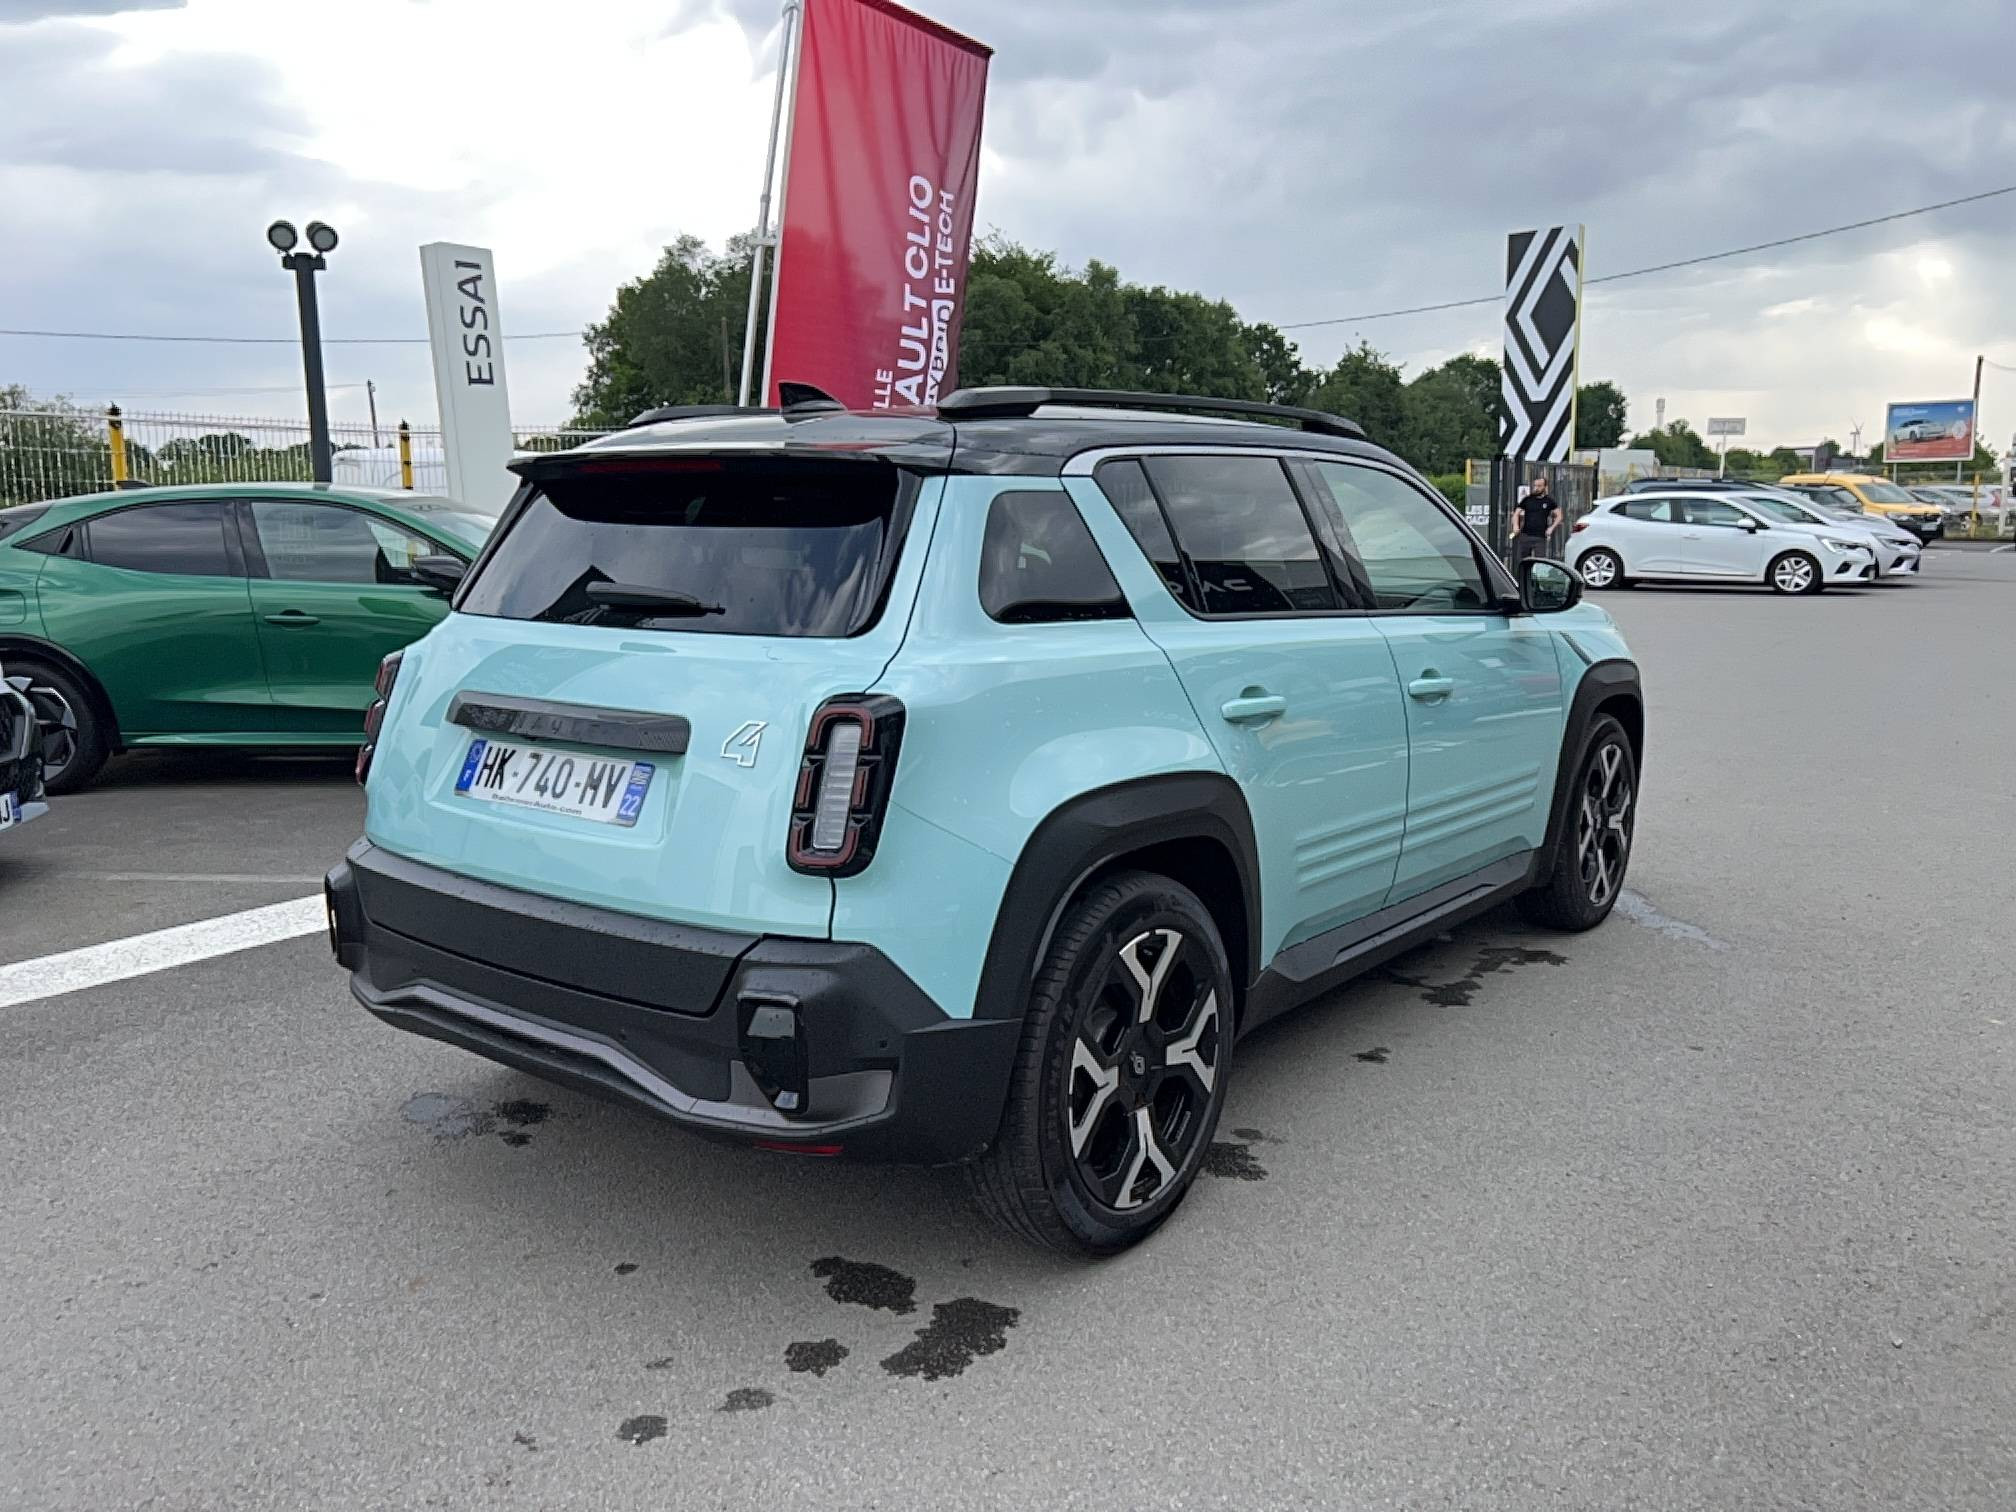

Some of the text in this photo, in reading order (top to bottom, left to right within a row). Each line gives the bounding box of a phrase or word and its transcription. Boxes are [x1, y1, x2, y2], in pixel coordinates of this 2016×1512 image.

[895, 175, 933, 405] AULT CLIO
[934, 189, 955, 294] E-TECH
[455, 260, 494, 385] ESSAI
[873, 368, 893, 408] LLE
[620, 794, 640, 816] 22
